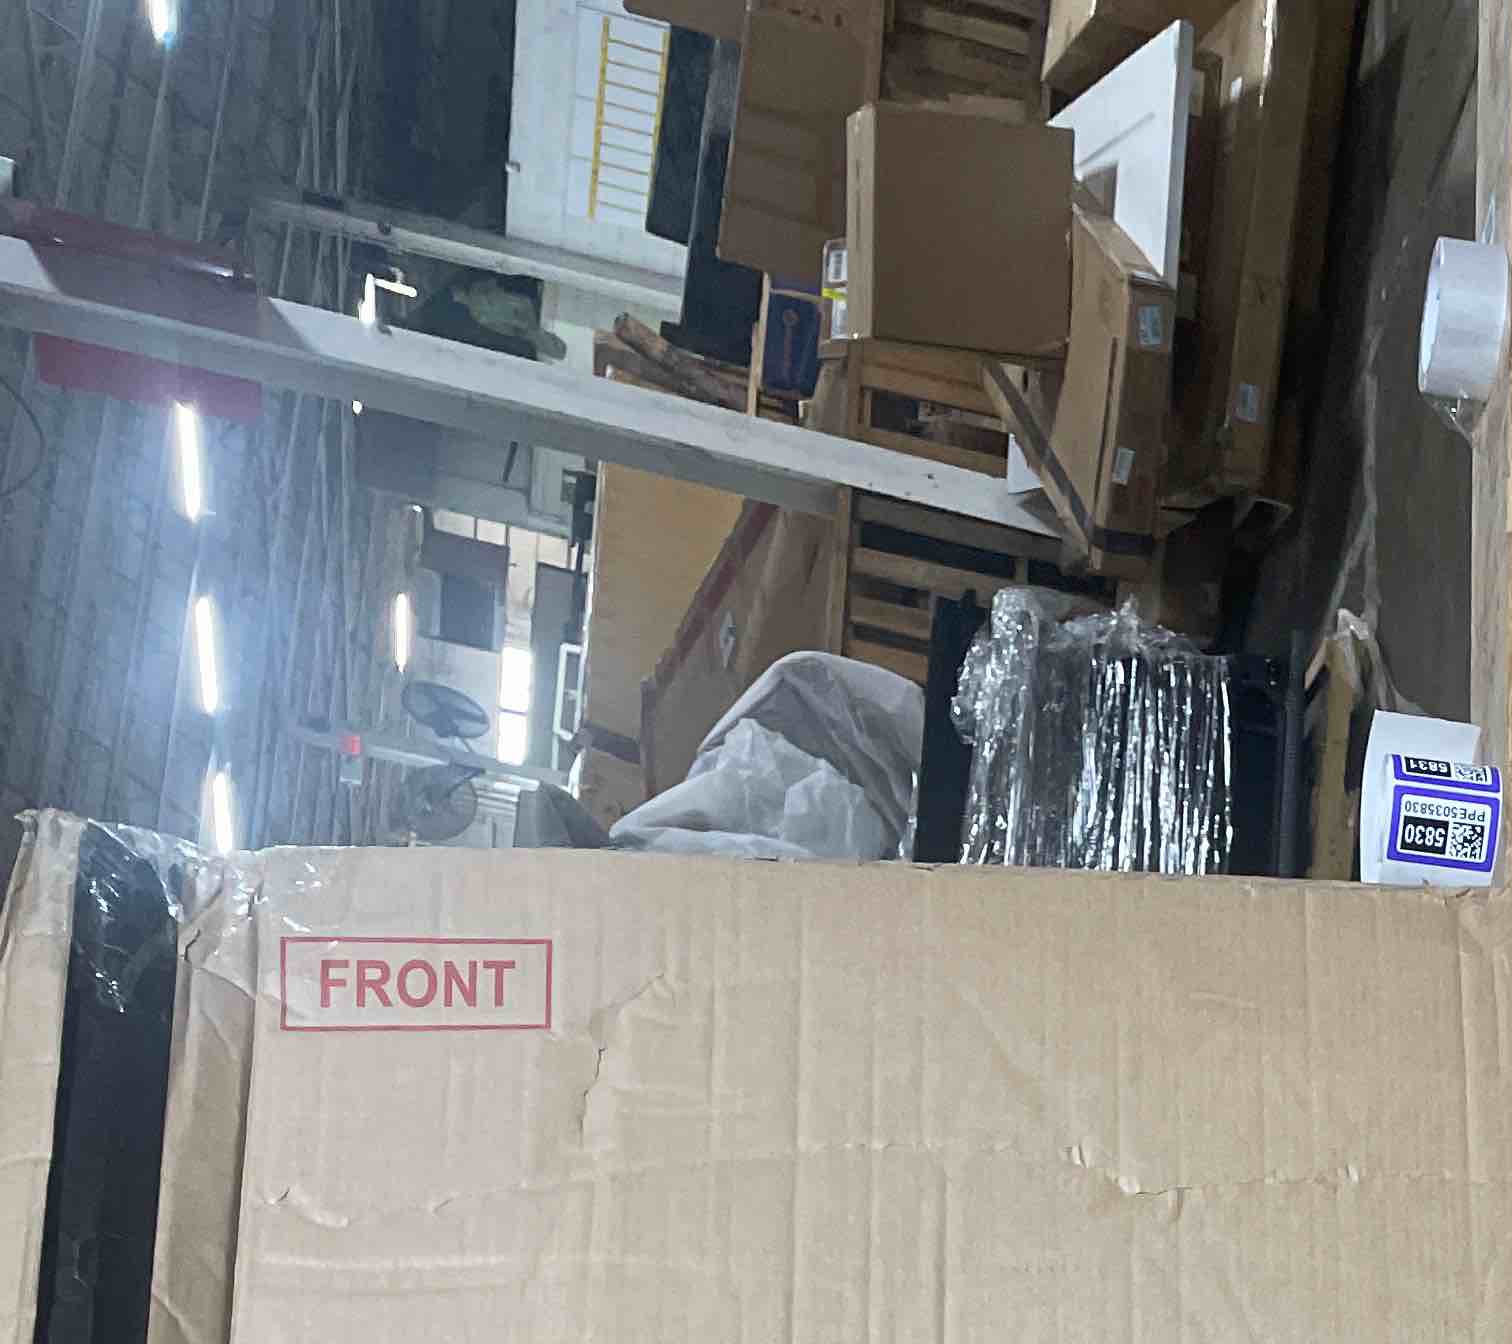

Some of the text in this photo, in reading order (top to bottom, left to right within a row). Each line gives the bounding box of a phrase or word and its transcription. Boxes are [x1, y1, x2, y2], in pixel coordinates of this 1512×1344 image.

[1404, 801, 1486, 822] PPE5035830
[1404, 824, 1446, 847] 5830
[319, 958, 516, 1009] FRONT
